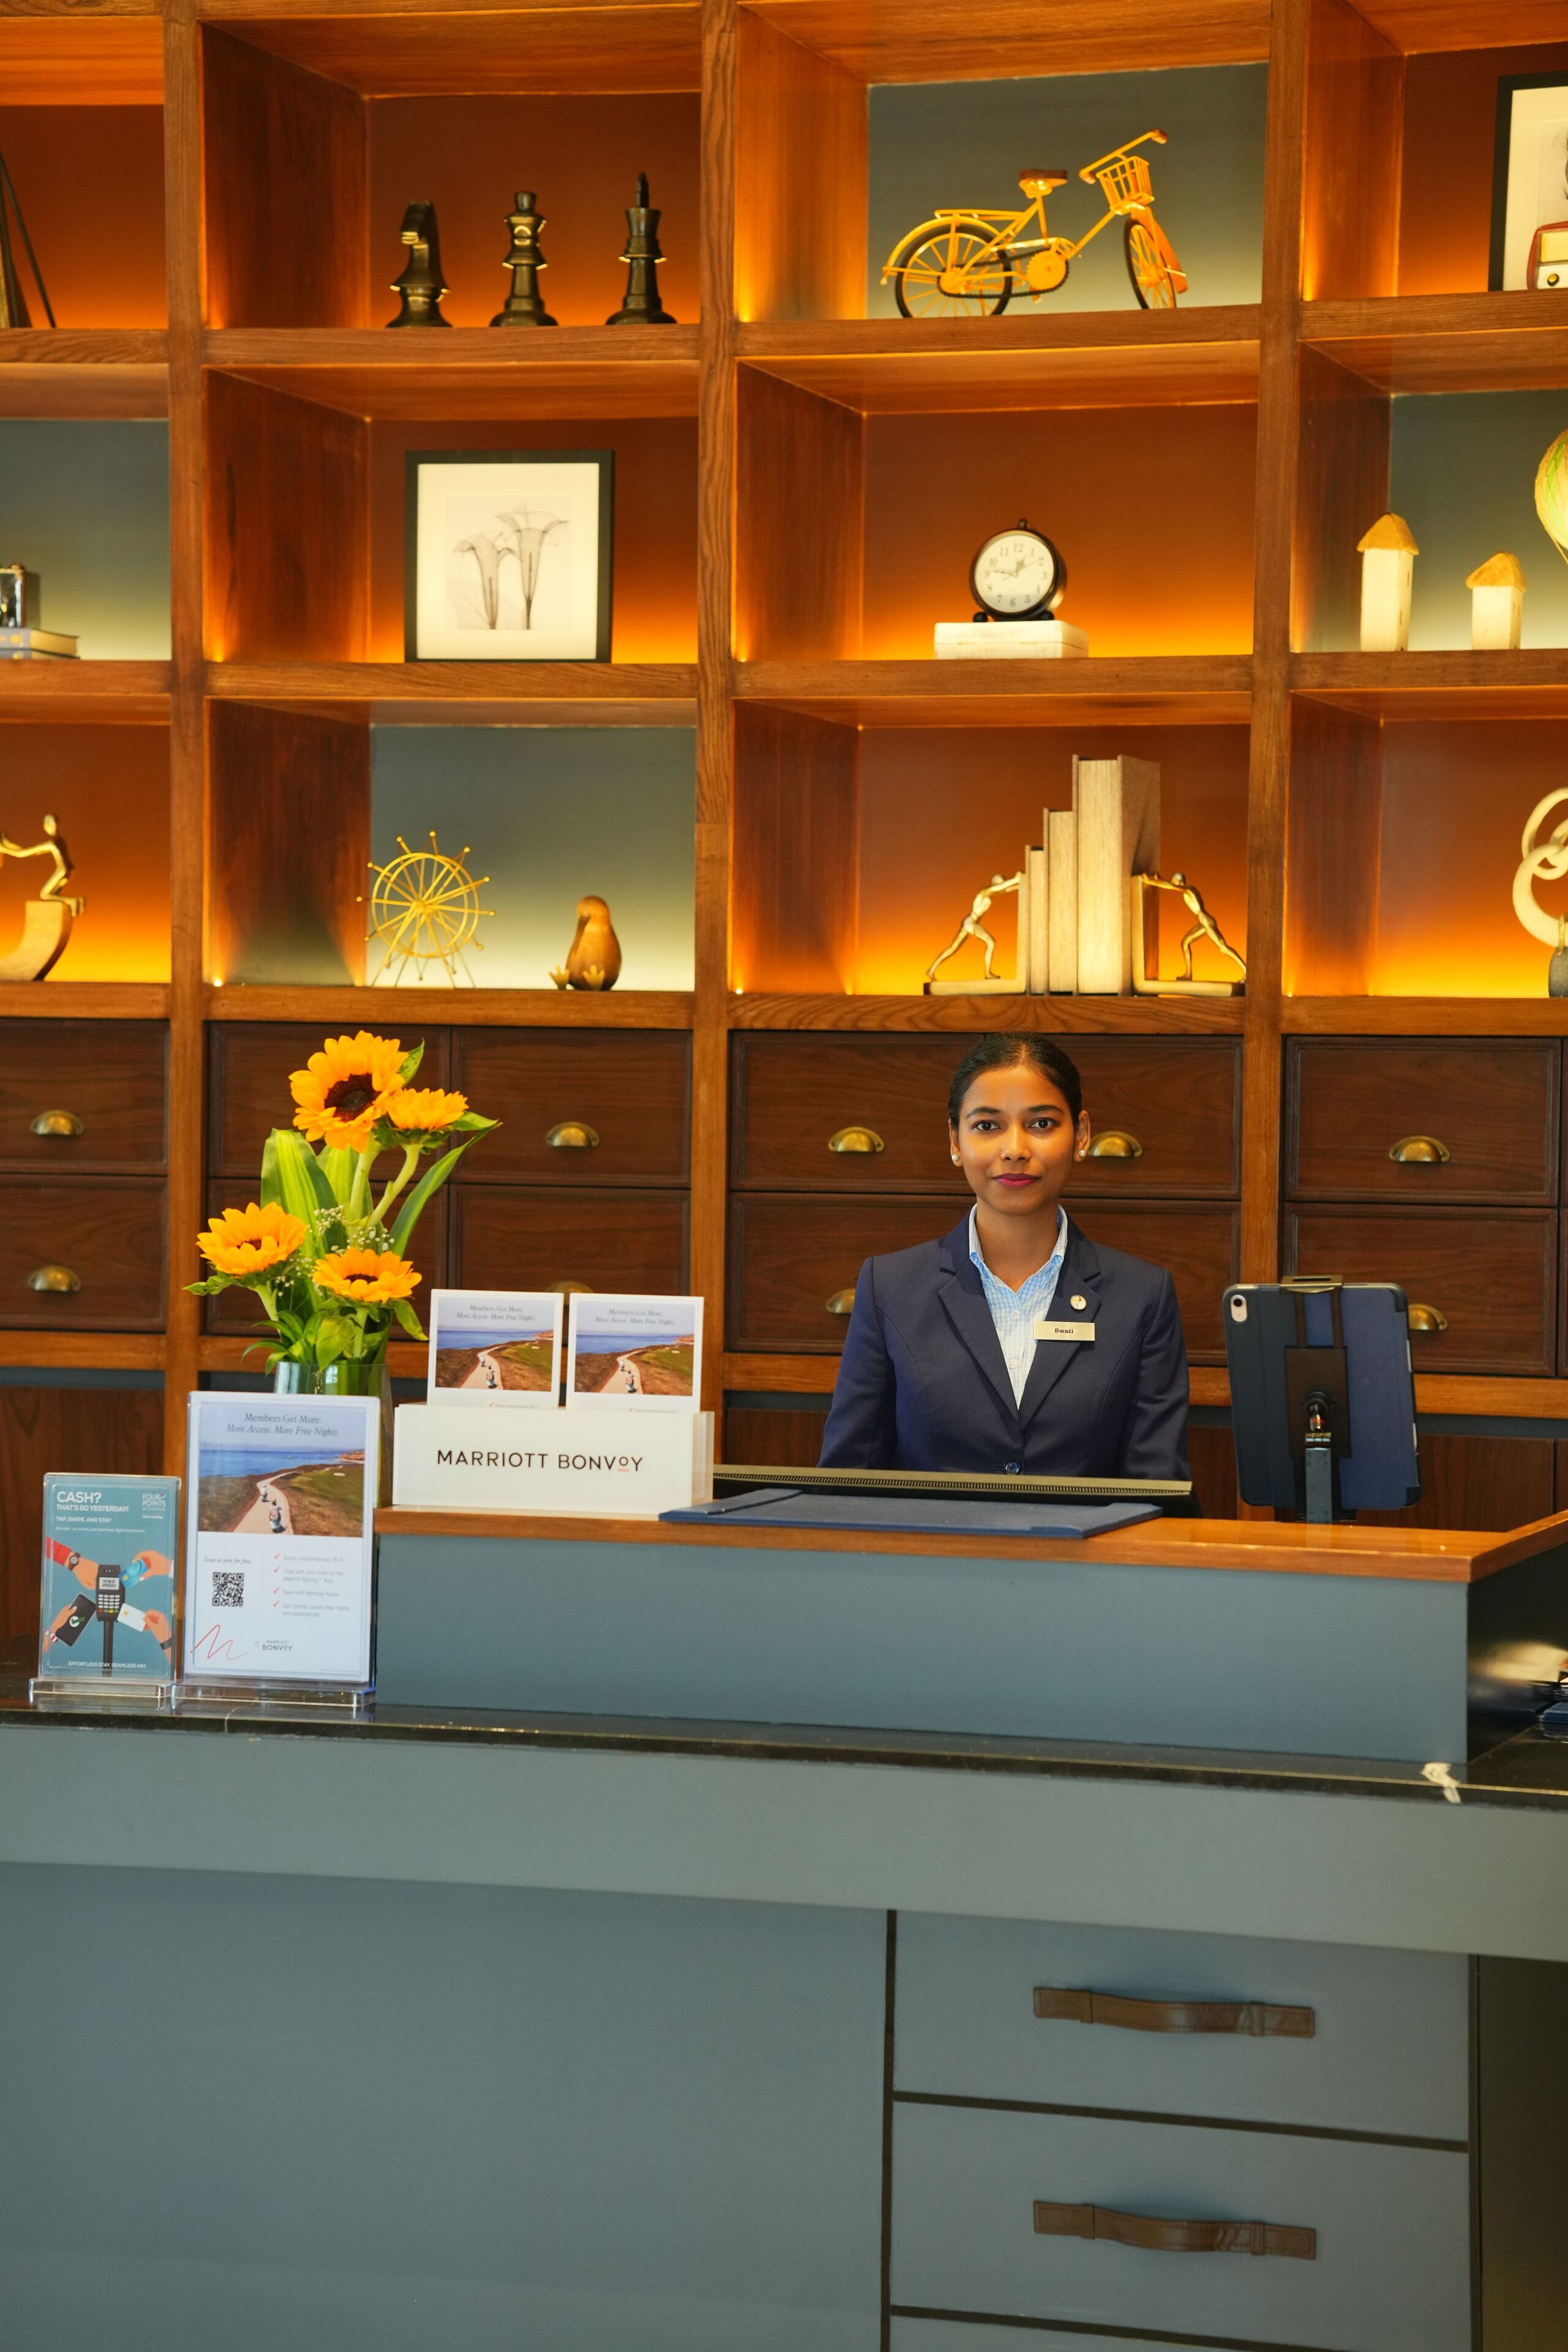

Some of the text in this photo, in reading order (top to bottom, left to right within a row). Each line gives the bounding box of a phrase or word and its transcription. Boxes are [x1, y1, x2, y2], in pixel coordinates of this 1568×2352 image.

[1000, 547, 1009, 557] 11
[1014, 543, 1024, 552] 12
[1030, 547, 1035, 557] 1
[1041, 570, 1047, 580] 3
[997, 594, 1003, 604] 7
[1009, 598, 1016, 608] 6
[1024, 594, 1031, 604] 5
[245, 1413, 322, 1424] Members Get More.
[225, 1423, 339, 1438] More Access. More Free Nights.
[437, 1450, 643, 1472] MARRIOTT BONVOY
[56, 1491, 102, 1503] CASH?
